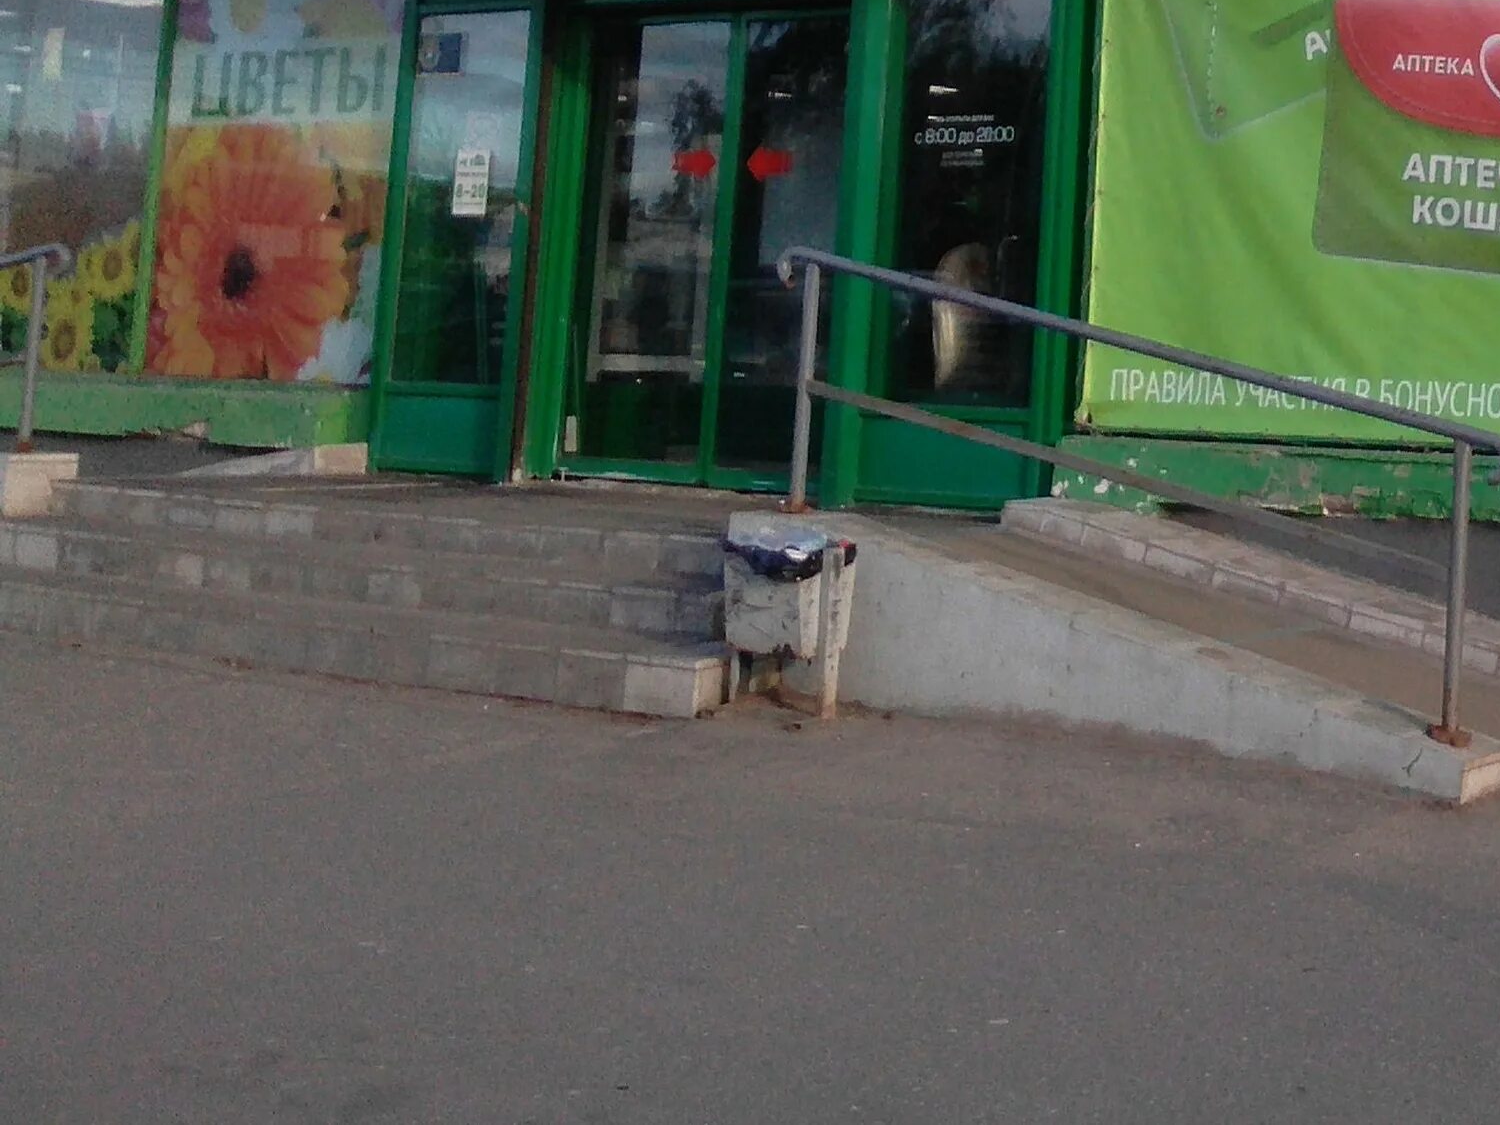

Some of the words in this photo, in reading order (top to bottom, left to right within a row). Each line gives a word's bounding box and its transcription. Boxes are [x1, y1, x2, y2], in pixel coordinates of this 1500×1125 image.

[192, 43, 389, 117] ЦВЕТЫ
[1392, 52, 1475, 77] АПТЕКА
[1109, 368, 1226, 407] ПРАВИЛА
